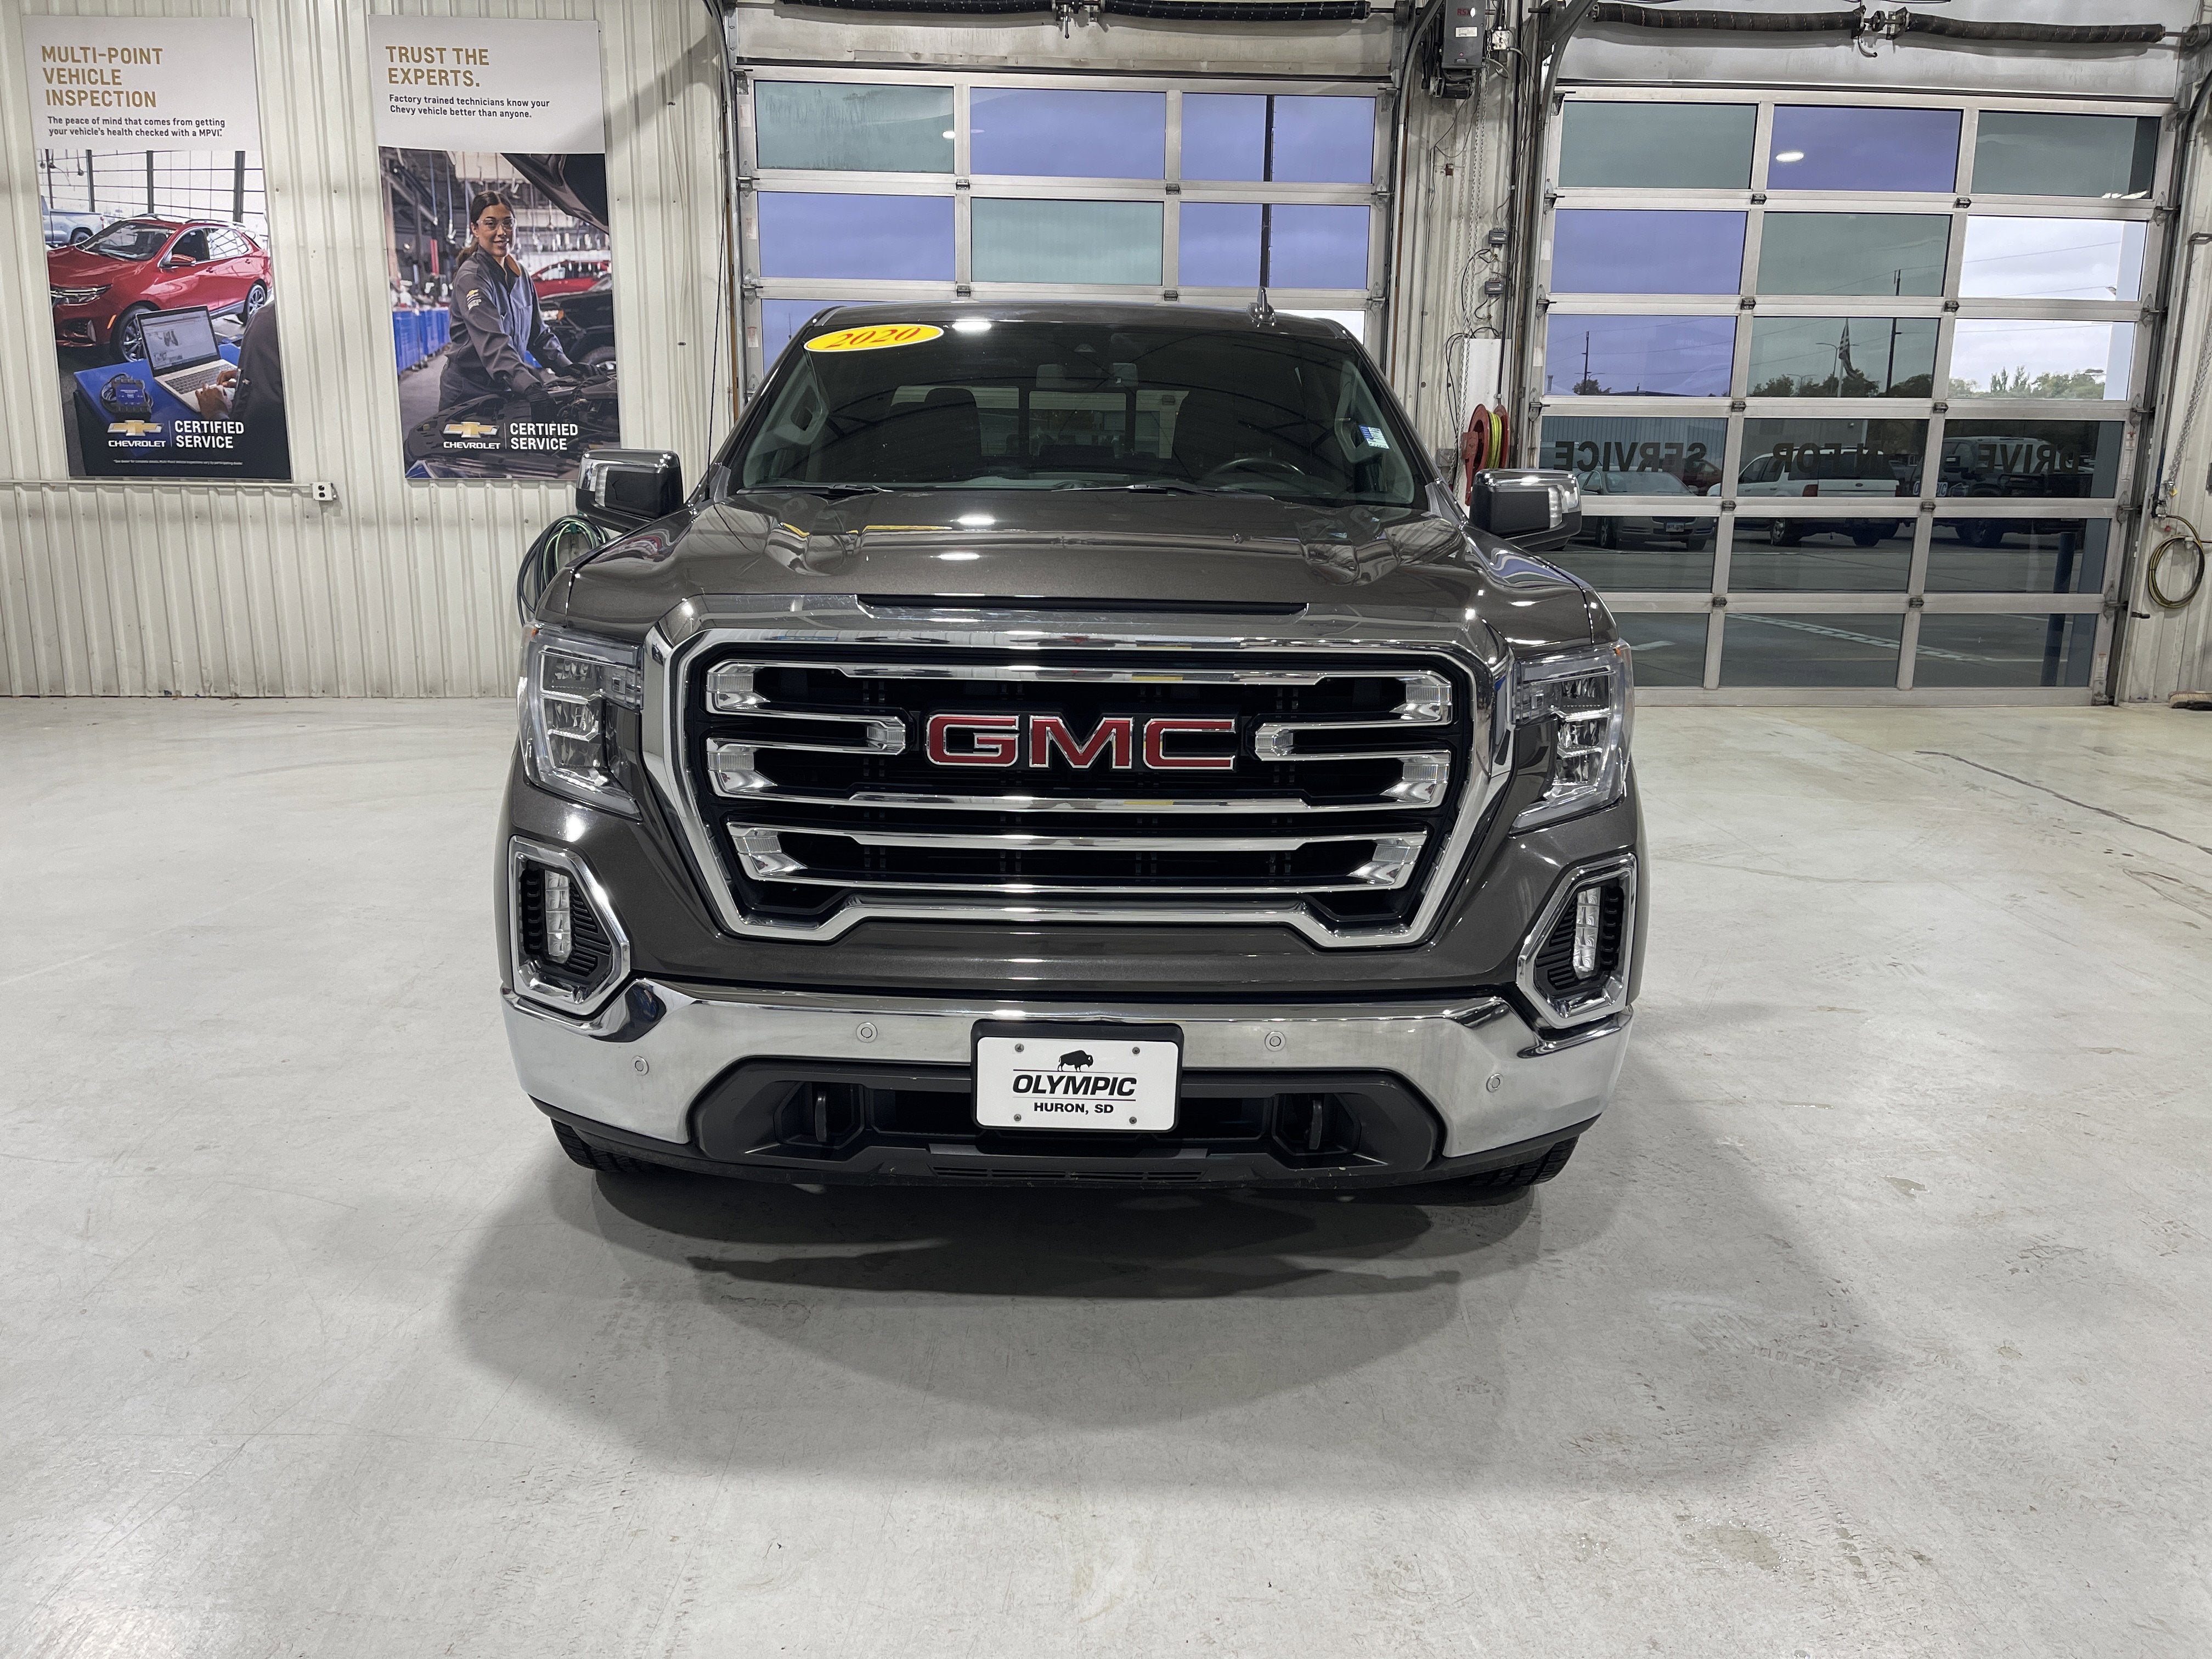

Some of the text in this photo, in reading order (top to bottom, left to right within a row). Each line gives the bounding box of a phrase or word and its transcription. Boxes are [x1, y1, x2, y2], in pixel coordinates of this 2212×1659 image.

[41, 46, 163, 65] MULTI-POINT
[385, 46, 489, 66] TRUST THE
[43, 67, 122, 86] VEHICLE
[388, 67, 481, 88] EXPERTS.
[46, 89, 157, 108] INSPECTION
[389, 94, 550, 109] Factory trained technicians know your
[390, 105, 532, 120] Chevy vehicle better than anyone.
[48, 116, 225, 128] The peace of mind that comes from getting
[49, 128, 67, 137] your
[70, 127, 105, 136] vehicle's
[107, 127, 133, 136] health
[135, 128, 169, 137] checked
[171, 128, 190, 137] with
[825, 327, 921, 348] 2020
[174, 420, 245, 435] CERTIFIED
[510, 422, 578, 436] CERTIFIED
[175, 435, 234, 449] SERVICE
[443, 441, 501, 450] CHEVROLET
[510, 437, 568, 450] SERVICE
[926, 714, 1237, 770] GMC
[1013, 1074, 1137, 1096] OLYMPIC
[1034, 1102, 1114, 1115] HURON, SD
